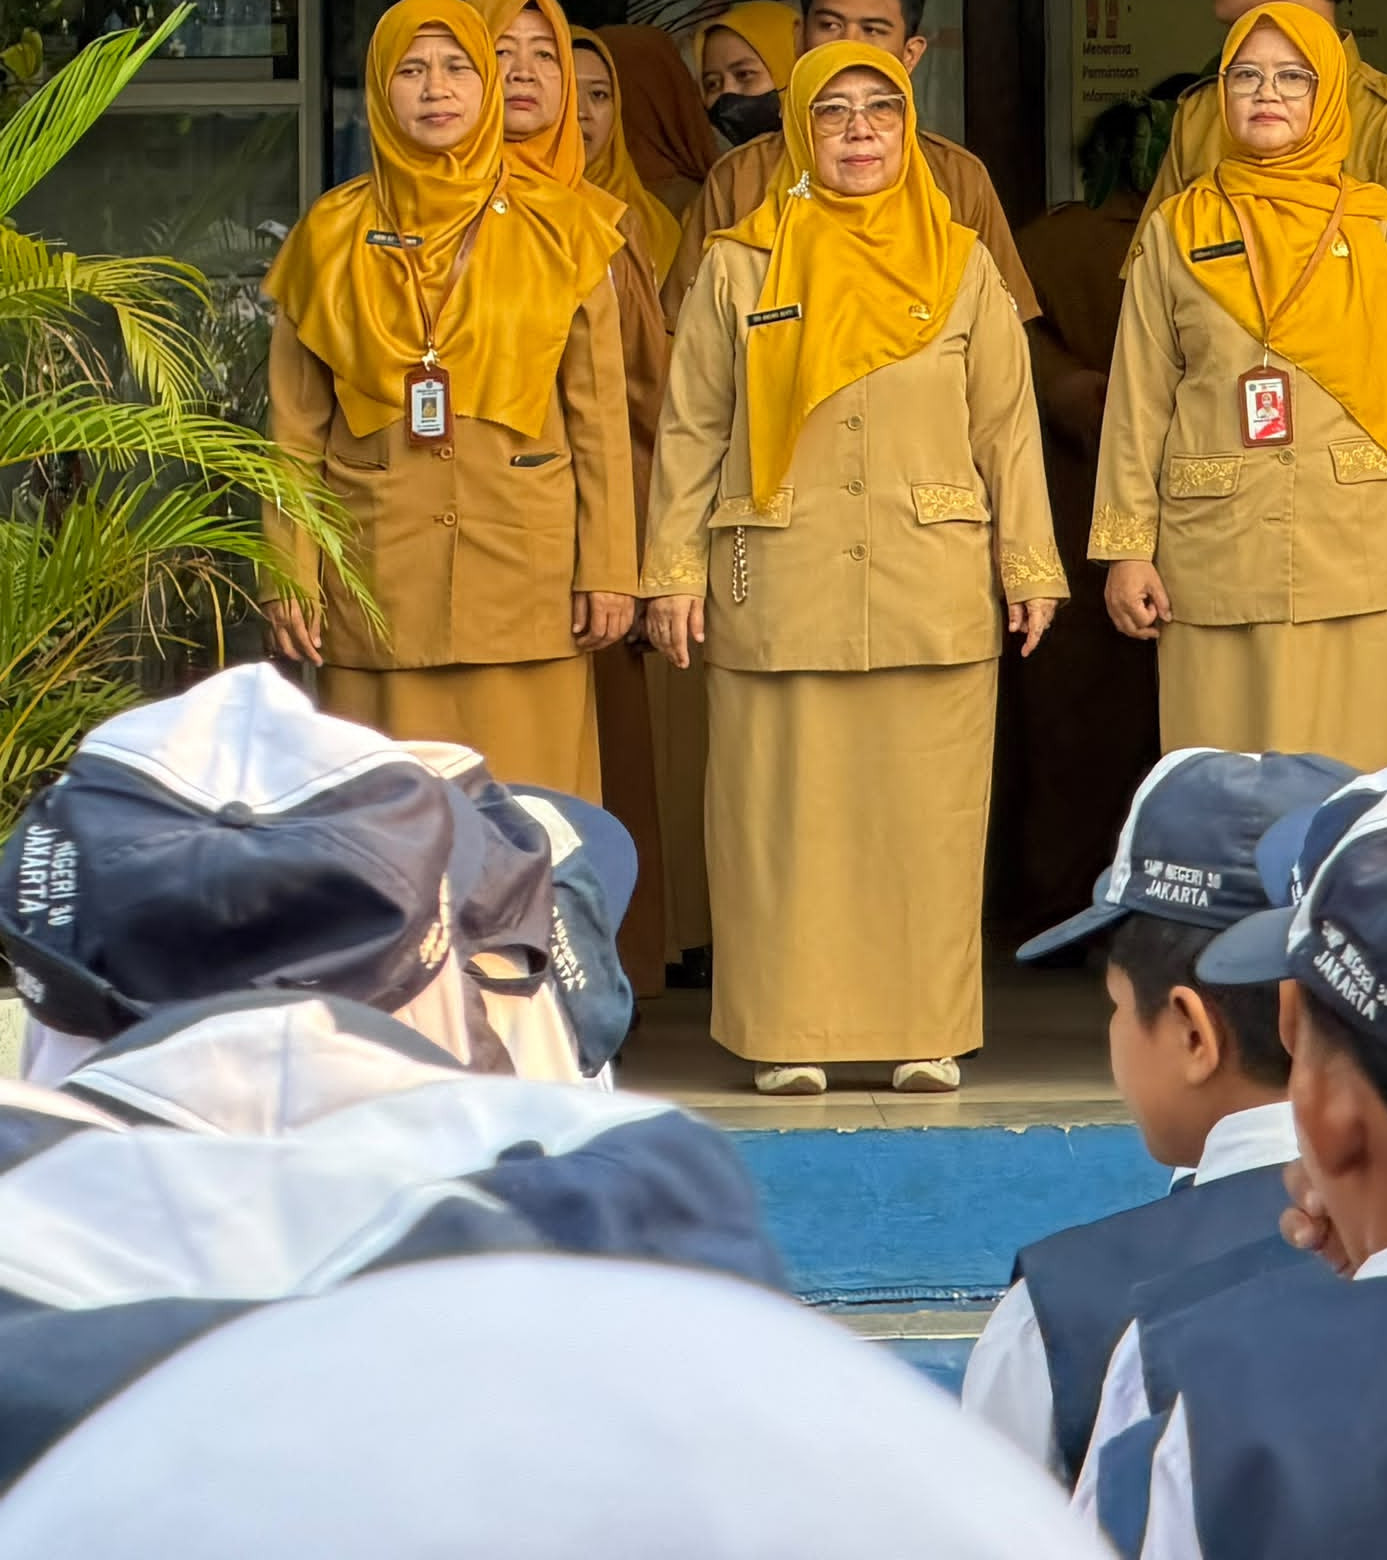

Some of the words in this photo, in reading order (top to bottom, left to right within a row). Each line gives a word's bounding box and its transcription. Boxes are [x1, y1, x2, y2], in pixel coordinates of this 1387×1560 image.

[18, 824, 60, 914] JAKARTA
[47, 840, 78, 900] NEGERI
[1145, 879, 1209, 908] JAKARTA
[1313, 950, 1379, 1021] JAKARTA
